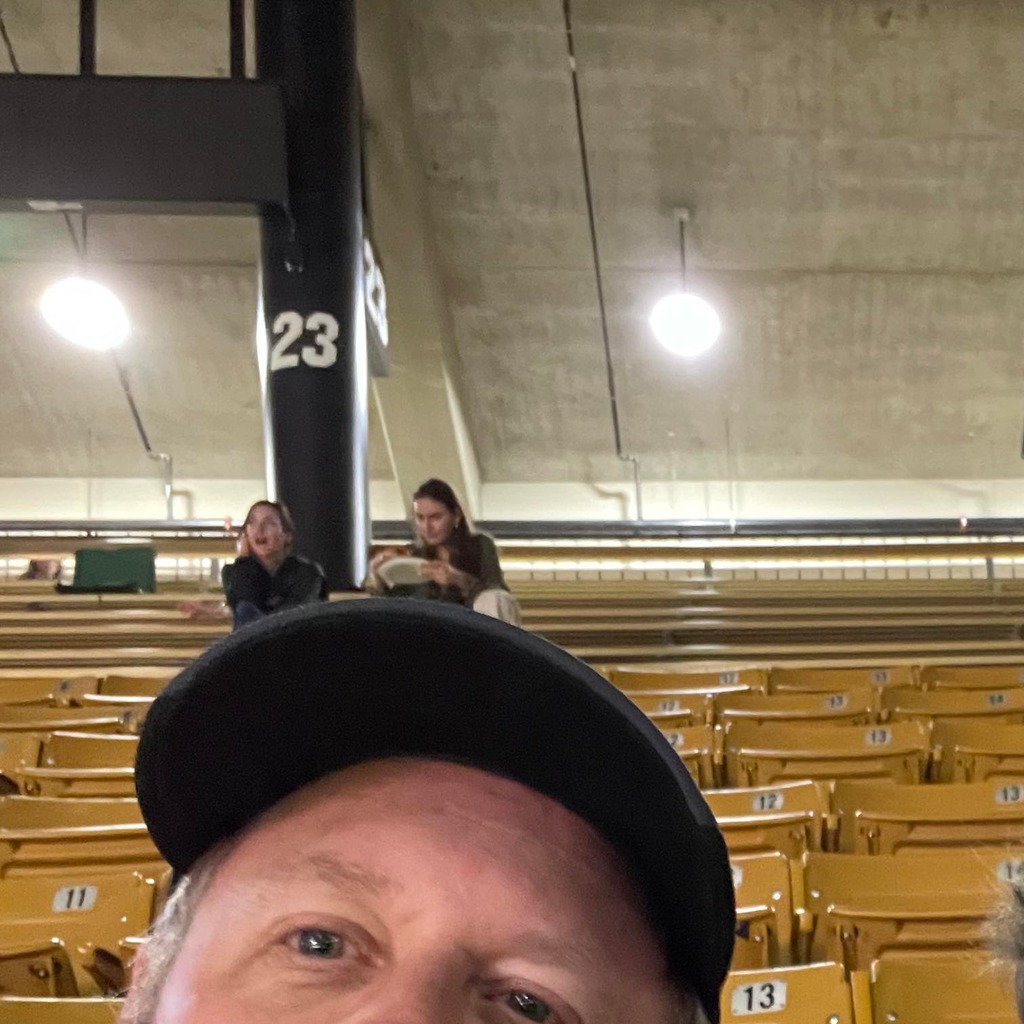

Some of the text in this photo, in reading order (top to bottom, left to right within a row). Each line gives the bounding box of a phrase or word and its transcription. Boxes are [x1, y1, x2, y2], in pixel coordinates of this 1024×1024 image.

[271, 311, 339, 370] 23
[871, 729, 887, 744] 13
[758, 795, 777, 810] 12
[1001, 786, 1020, 802] 13
[66, 887, 86, 909] 11
[743, 982, 776, 1011] 13
